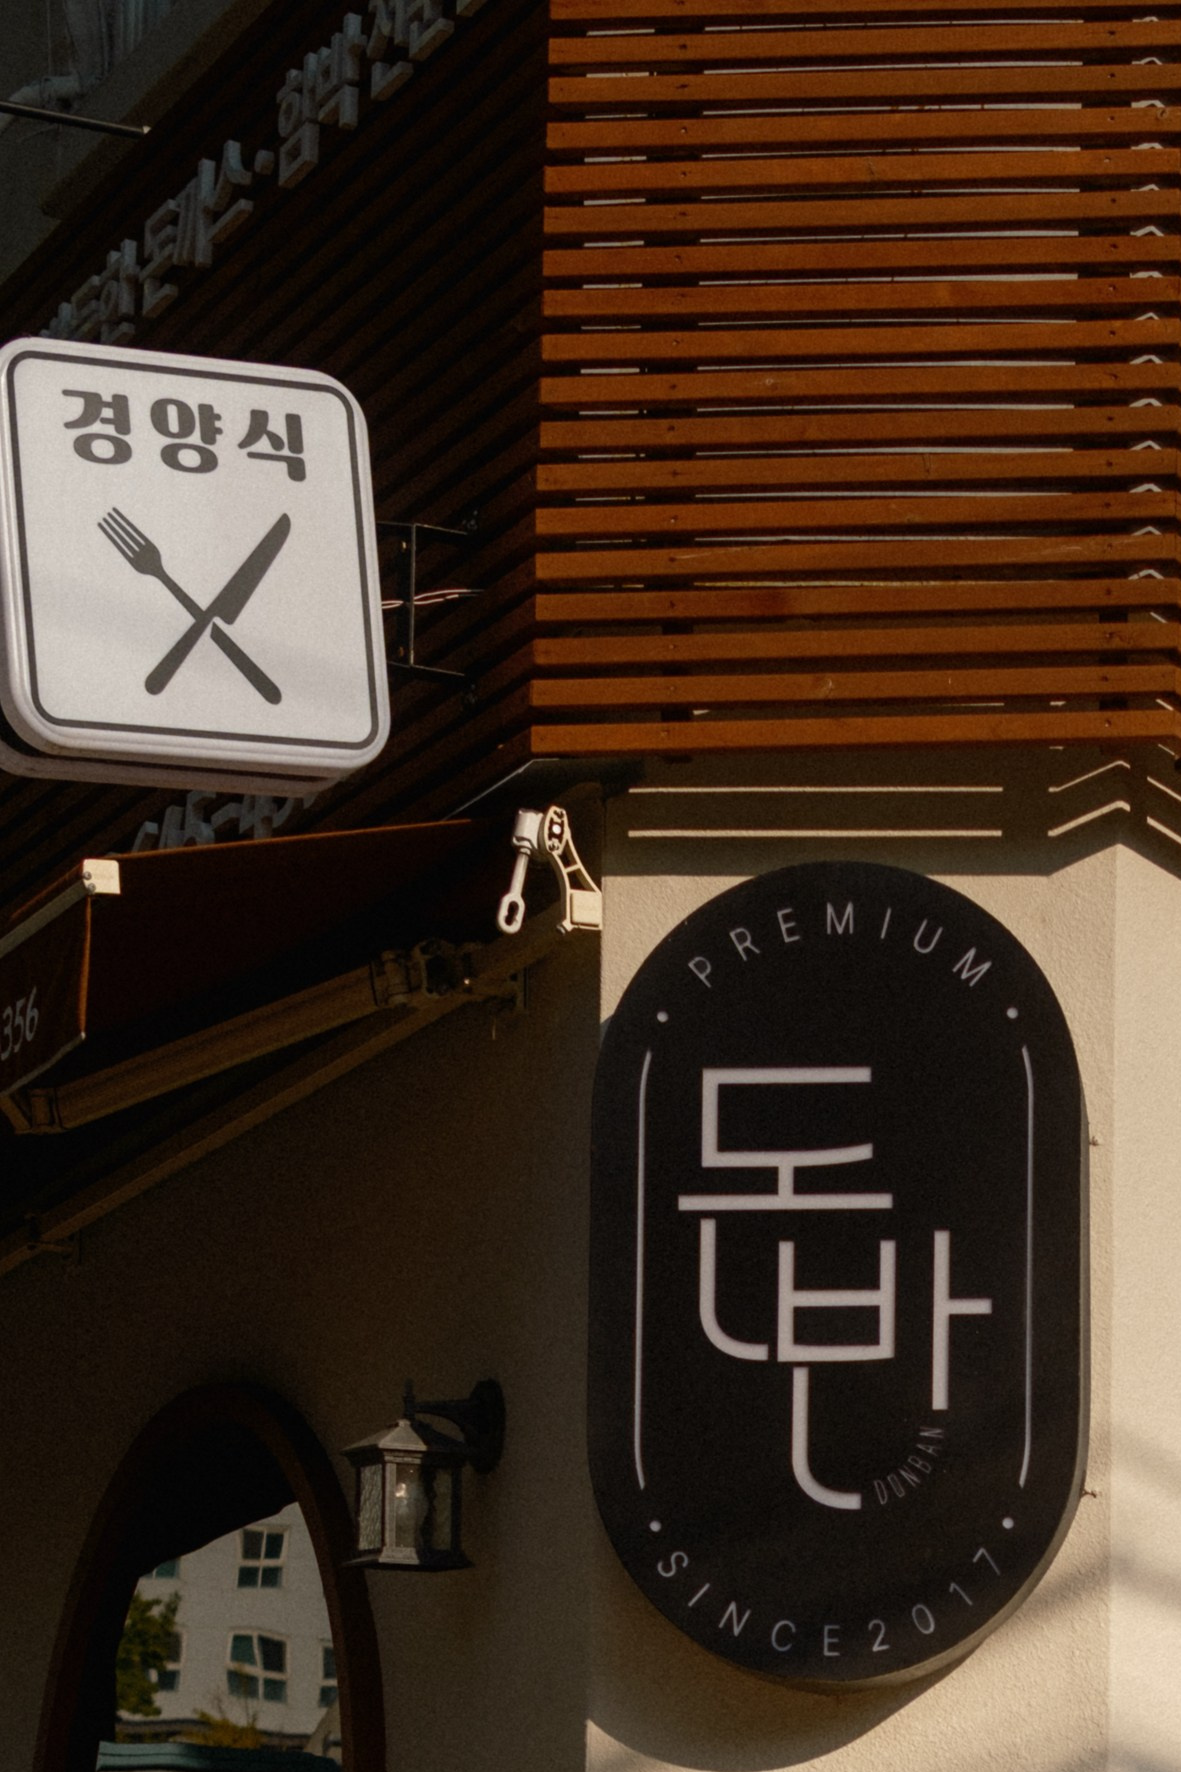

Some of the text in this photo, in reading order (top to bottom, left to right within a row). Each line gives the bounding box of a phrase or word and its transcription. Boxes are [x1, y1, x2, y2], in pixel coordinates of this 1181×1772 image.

[61, 388, 308, 483] 경양식
[687, 901, 993, 988] PREMIUM
[677, 1066, 993, 1511] 돈반
[873, 1426, 944, 1505] DONBAN
